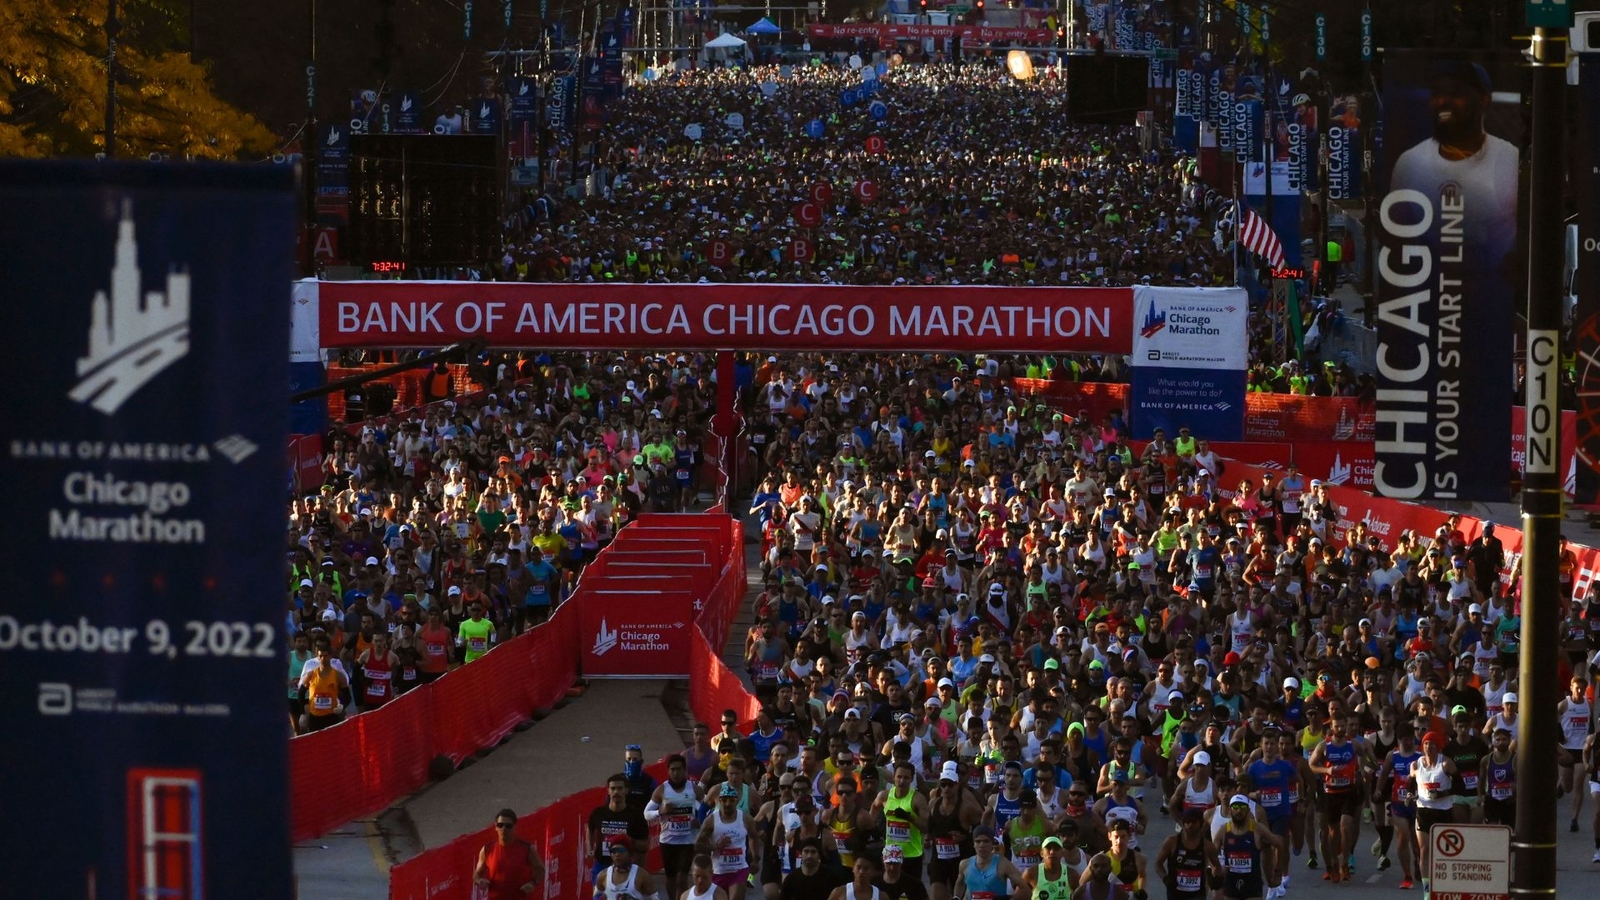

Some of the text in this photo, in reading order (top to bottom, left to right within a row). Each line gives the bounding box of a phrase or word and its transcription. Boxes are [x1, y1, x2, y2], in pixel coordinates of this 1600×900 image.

[834, 26, 880, 36] No re-entry
[907, 26, 954, 36] No re-entry
[994, 30, 1028, 39] re-entry
[1316, 17, 1325, 56] C130
[1362, 14, 1371, 56] C120
[306, 66, 315, 107] C121
[1179, 70, 1187, 114] CHICAGO
[1192, 72, 1201, 122] CHICAGO
[551, 77, 564, 127] CHICAGO
[1210, 78, 1219, 130] CHICAGO
[382, 103, 391, 134] C13
[811, 122, 819, 132] F
[1219, 91, 1230, 148] CHICAGO
[871, 138, 881, 149] D
[1235, 103, 1248, 164] CHICAGO
[1288, 123, 1300, 190] CHICAGO
[1328, 126, 1342, 200] CHICAGO
[814, 186, 826, 202] C
[860, 181, 872, 196] C
[801, 204, 814, 220] C
[314, 232, 334, 258] A
[712, 242, 726, 259] B
[794, 240, 806, 258] B
[338, 302, 1110, 337] BANK OF AMERICA CHICAGO MARATHON
[1169, 314, 1210, 326] Chicago
[1169, 324, 1220, 336] Marathon
[1373, 189, 1434, 499] CHICAGO
[1434, 194, 1465, 499] IS YOUR START LINE
[1148, 387, 1160, 395] like
[1162, 388, 1174, 396] the
[1176, 389, 1198, 398] power
[1158, 378, 1214, 390] What would you
[1529, 336, 1554, 466] C10N
[1246, 427, 1286, 438] Marathon
[1247, 415, 1279, 428] Chicago
[10, 440, 210, 462] BANK OF AMERICA
[64, 472, 190, 514] Chicago
[50, 508, 206, 543] Marathon
[0, 616, 276, 660] October 9, 2022
[620, 631, 660, 642] Chicago
[620, 641, 670, 650] Marathon
[1452, 864, 1492, 872] STOPPING
[1452, 873, 1492, 881] STANDING
